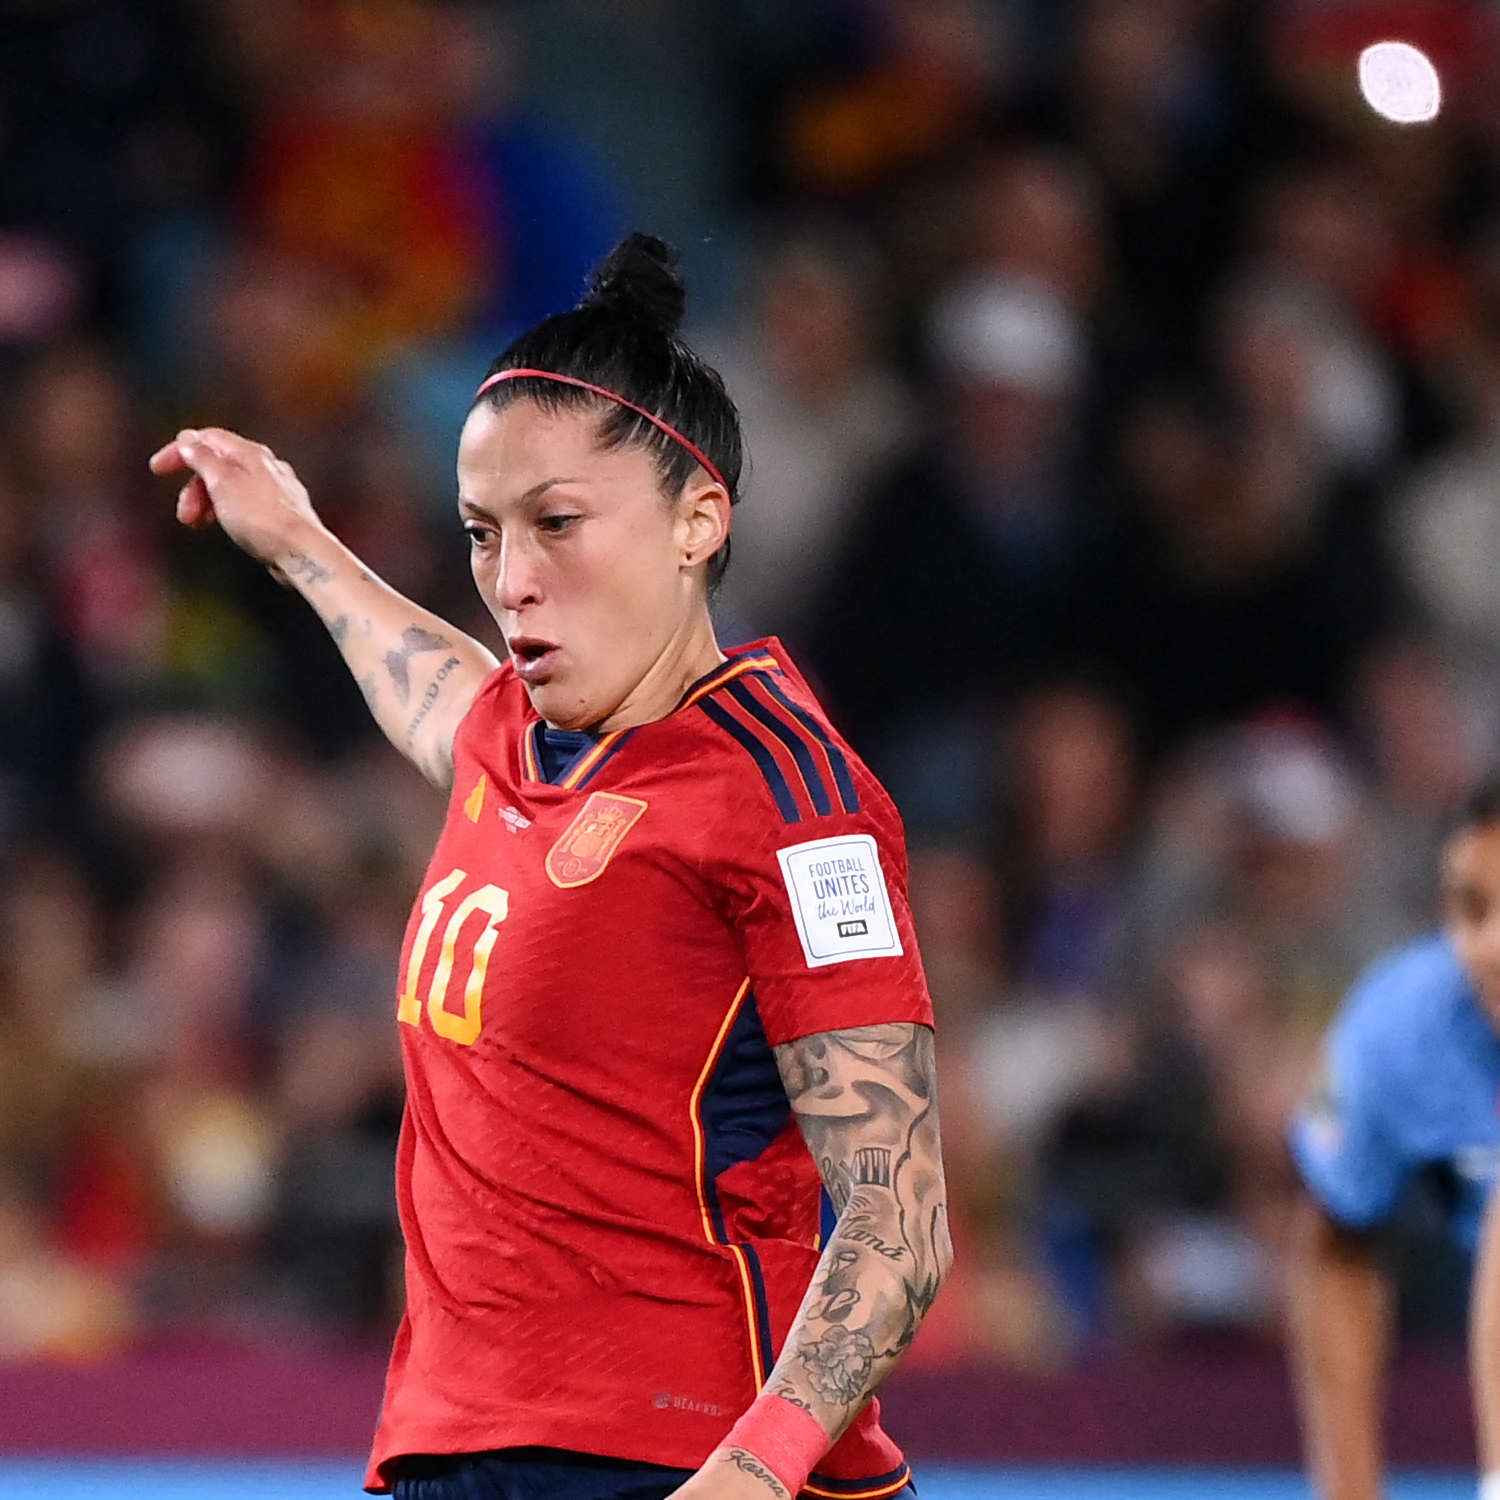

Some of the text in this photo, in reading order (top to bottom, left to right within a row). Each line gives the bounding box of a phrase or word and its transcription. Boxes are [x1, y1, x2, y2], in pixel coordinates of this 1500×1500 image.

[808, 857, 865, 878] FOOTBALL
[813, 873, 870, 899] UNITES
[817, 894, 877, 921] the World
[839, 921, 866, 937] FIFA
[396, 868, 509, 1046] 10
[725, 1450, 785, 1498] Karma
